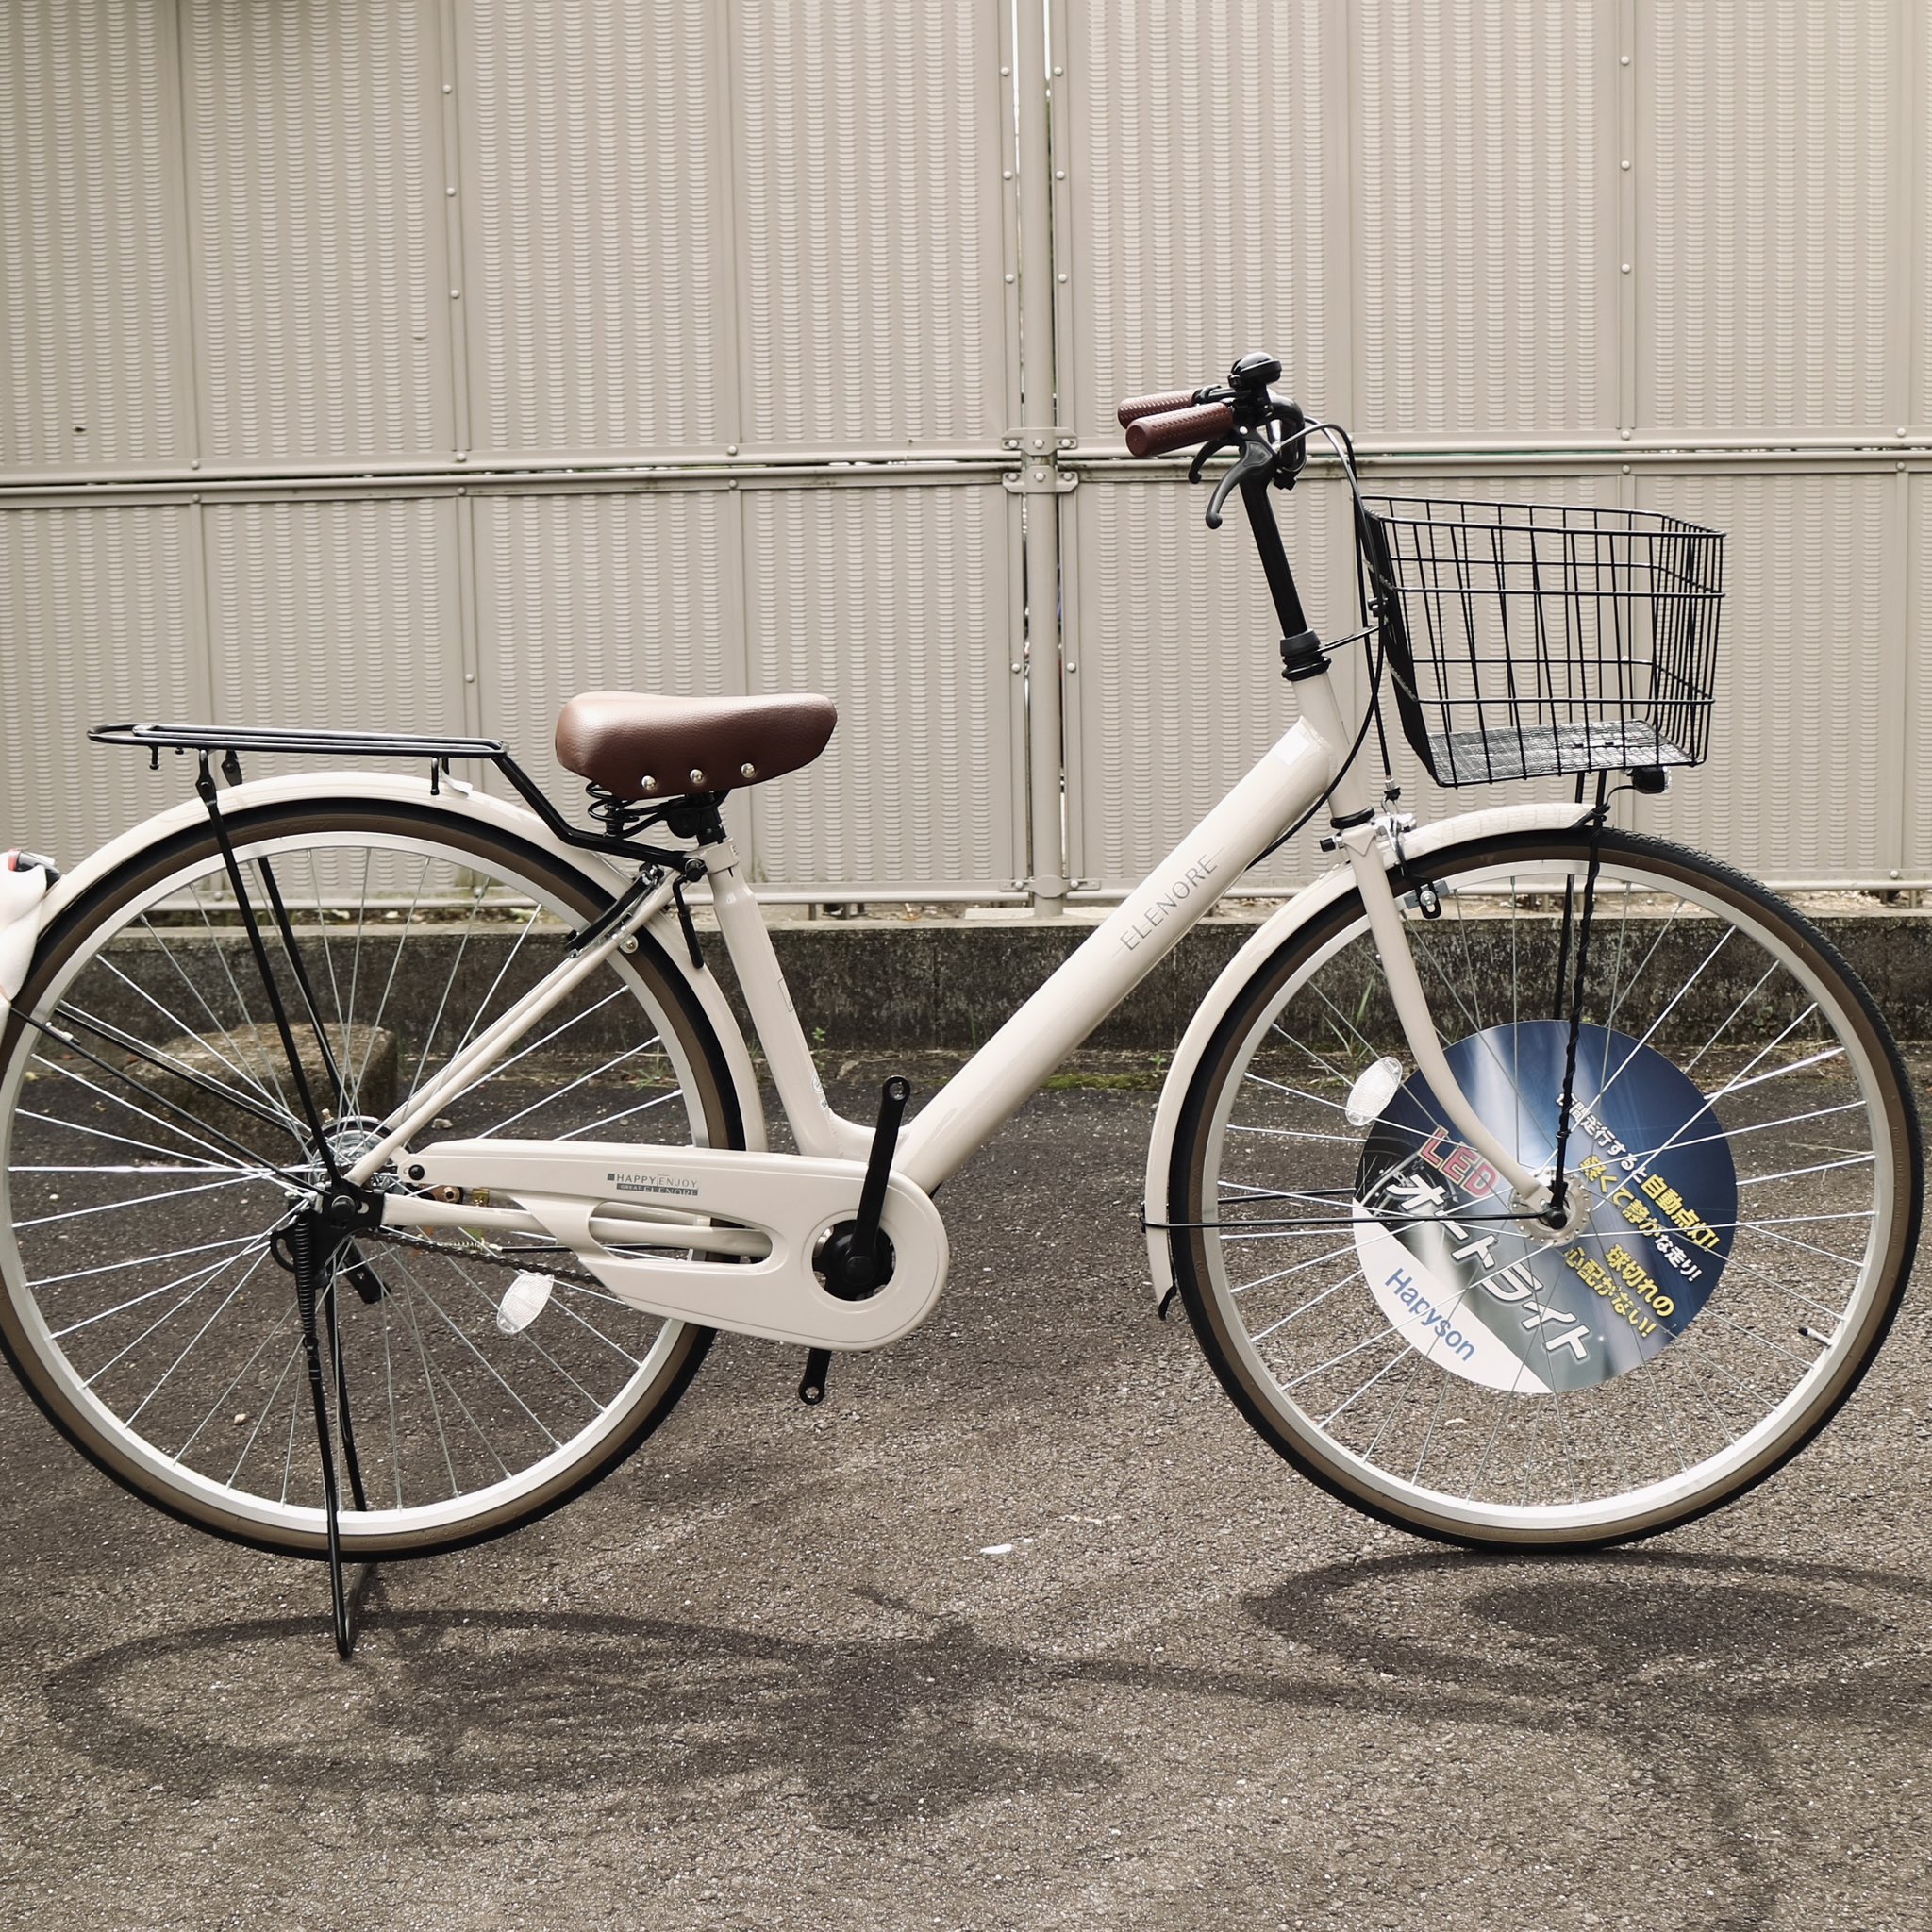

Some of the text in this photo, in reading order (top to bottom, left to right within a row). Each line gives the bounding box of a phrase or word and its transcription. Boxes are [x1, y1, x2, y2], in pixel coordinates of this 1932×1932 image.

[1120, 854, 1219, 951] ELENORE
[616, 1174, 698, 1188] HAPPY ENJOY
[1417, 1124, 1501, 1198] LED
[1386, 1174, 1591, 1360] オートライト
[1563, 1246, 1657, 1339] 心配がない!
[1605, 1243, 1675, 1318] 球切れの
[1384, 1267, 1475, 1362] Hapyson
